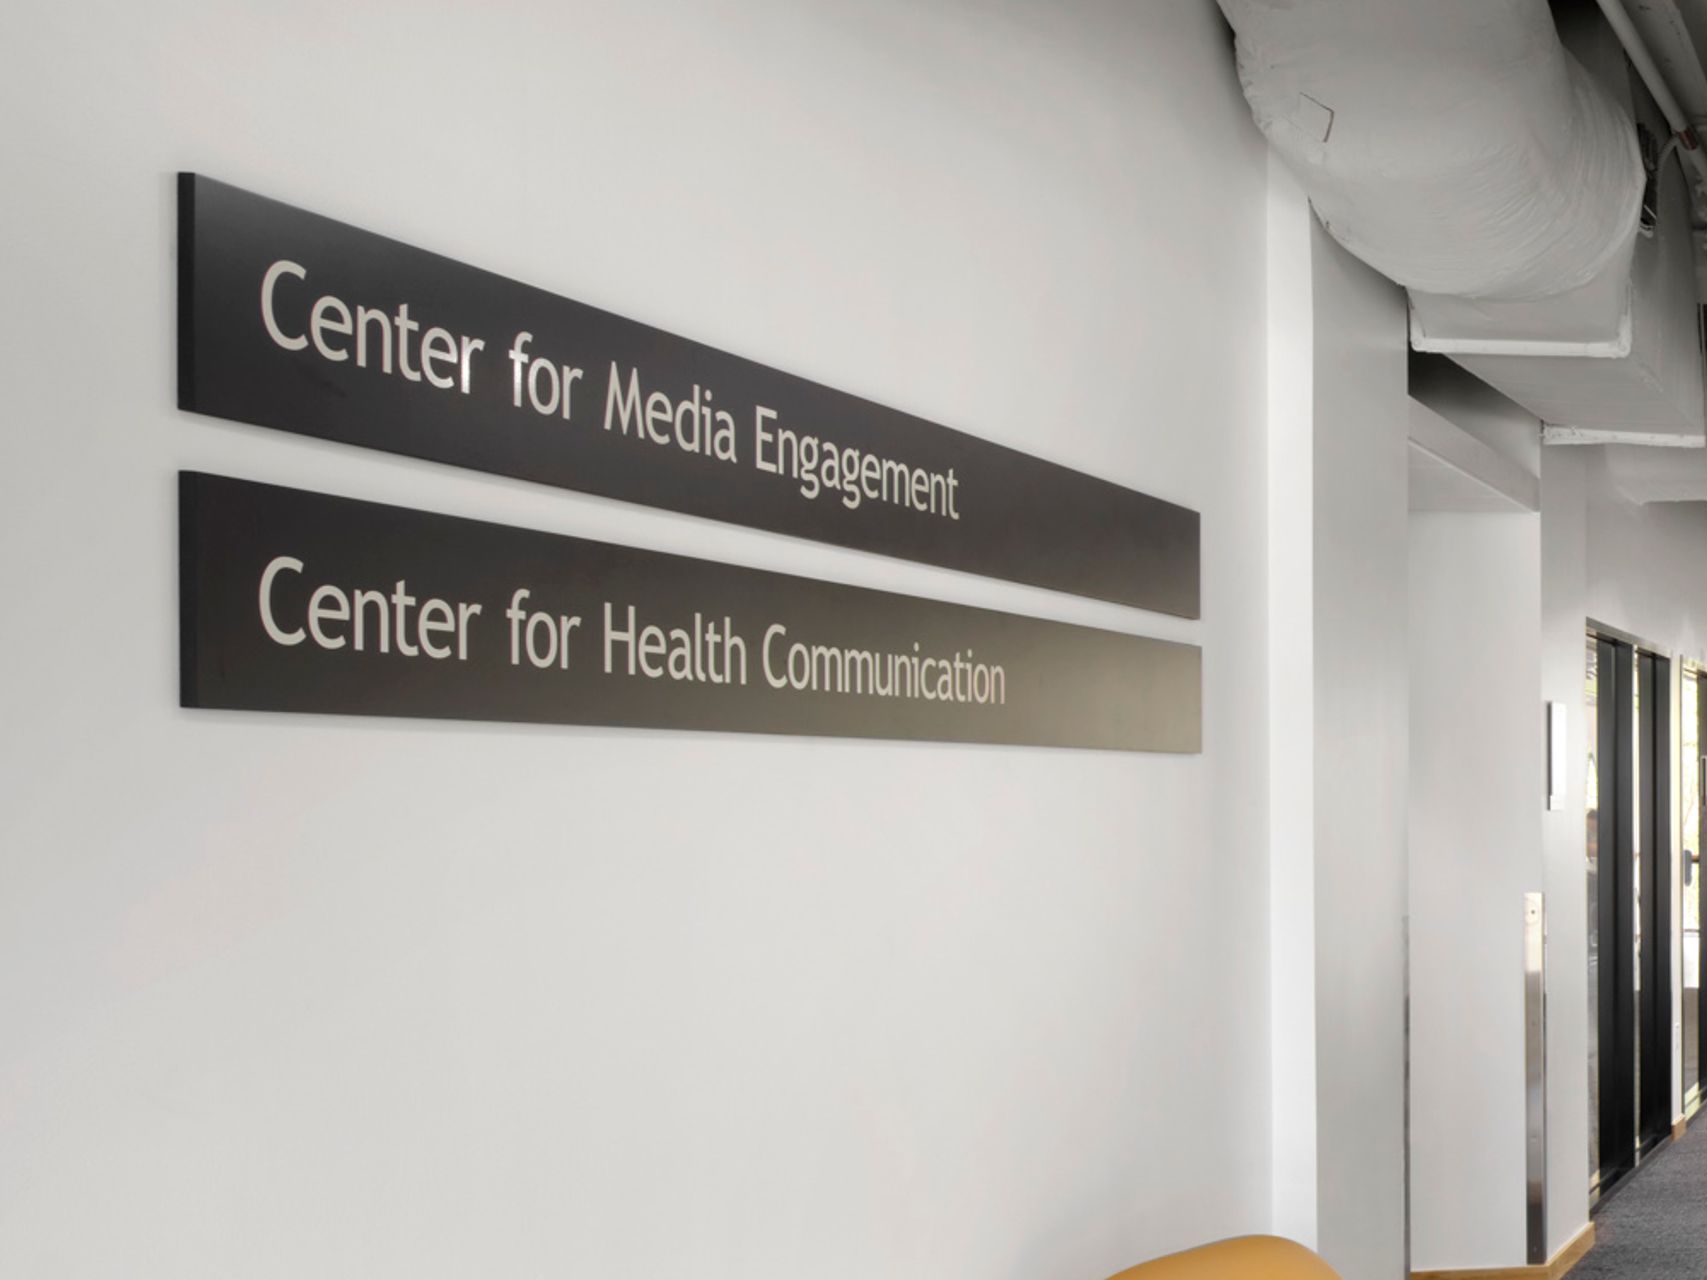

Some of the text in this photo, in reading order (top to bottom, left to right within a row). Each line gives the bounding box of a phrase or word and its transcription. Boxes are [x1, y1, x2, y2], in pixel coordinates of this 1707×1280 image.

[261, 260, 960, 520] Center for Media Engagement
[259, 556, 1006, 705] Center for Health Communication
